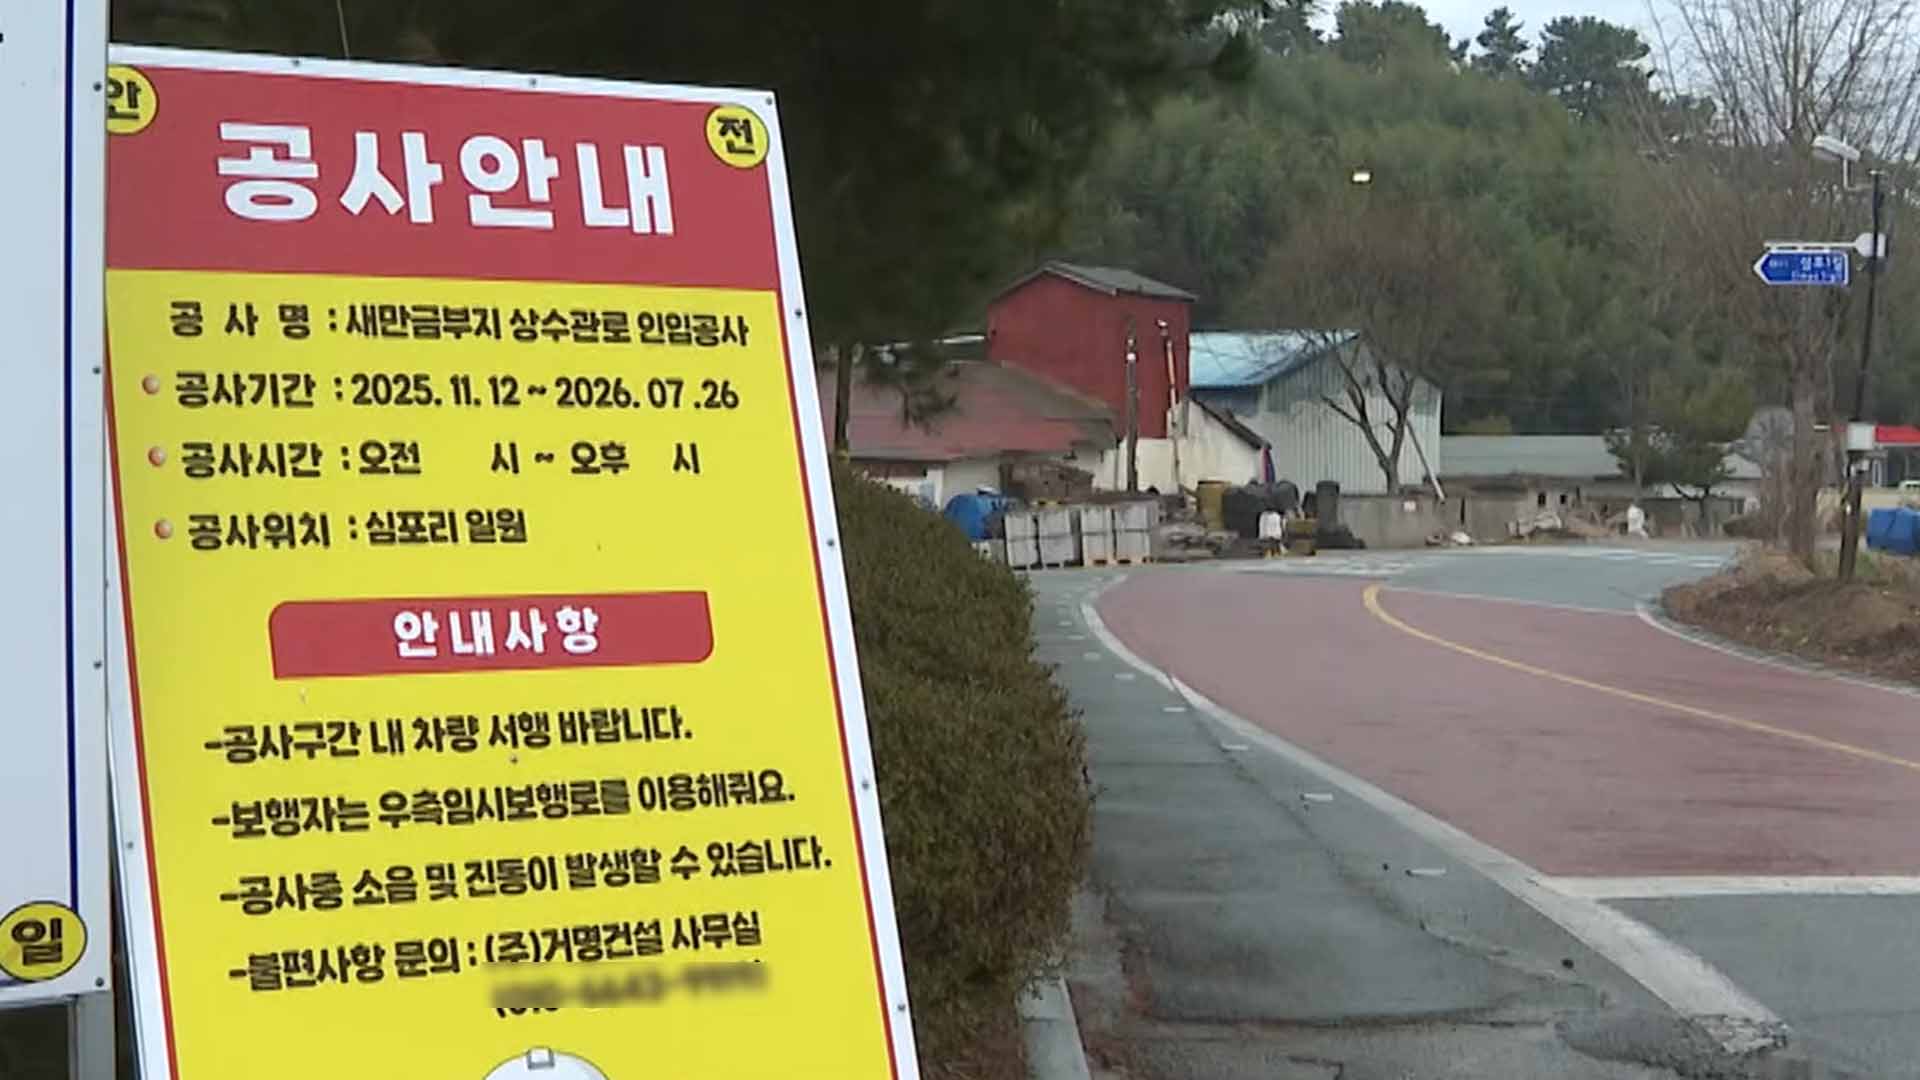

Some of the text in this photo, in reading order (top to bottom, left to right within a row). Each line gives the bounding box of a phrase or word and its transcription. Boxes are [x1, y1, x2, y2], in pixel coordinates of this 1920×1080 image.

[716, 117, 755, 154] 전
[219, 123, 673, 233] 공사안내
[510, 309, 630, 343] 상수관로
[638, 312, 748, 346] 인입공사
[176, 372, 316, 408] 공사기간
[182, 443, 322, 478] 공사시간
[492, 443, 519, 474] 시
[572, 442, 629, 474] 오후
[674, 443, 699, 474] 시
[189, 512, 330, 550] 공사위치
[466, 509, 526, 543] 일원
[395, 607, 598, 656] 안내사항
[370, 719, 404, 754] 내
[413, 716, 479, 752] 차량
[489, 712, 550, 748] 서행
[559, 706, 691, 744] 바랍니다.
[379, 780, 630, 828] 우측임시보행로를
[638, 770, 794, 810] 이용해줘요.
[353, 866, 417, 905] 소음
[426, 864, 458, 900] 및
[465, 856, 558, 897] 진동이
[566, 849, 661, 889] 발생할
[671, 846, 700, 880] 수
[707, 836, 831, 877] 있습니다.
[11, 918, 63, 966] 일
[395, 938, 460, 977] 문의
[672, 911, 760, 949] 사무실
